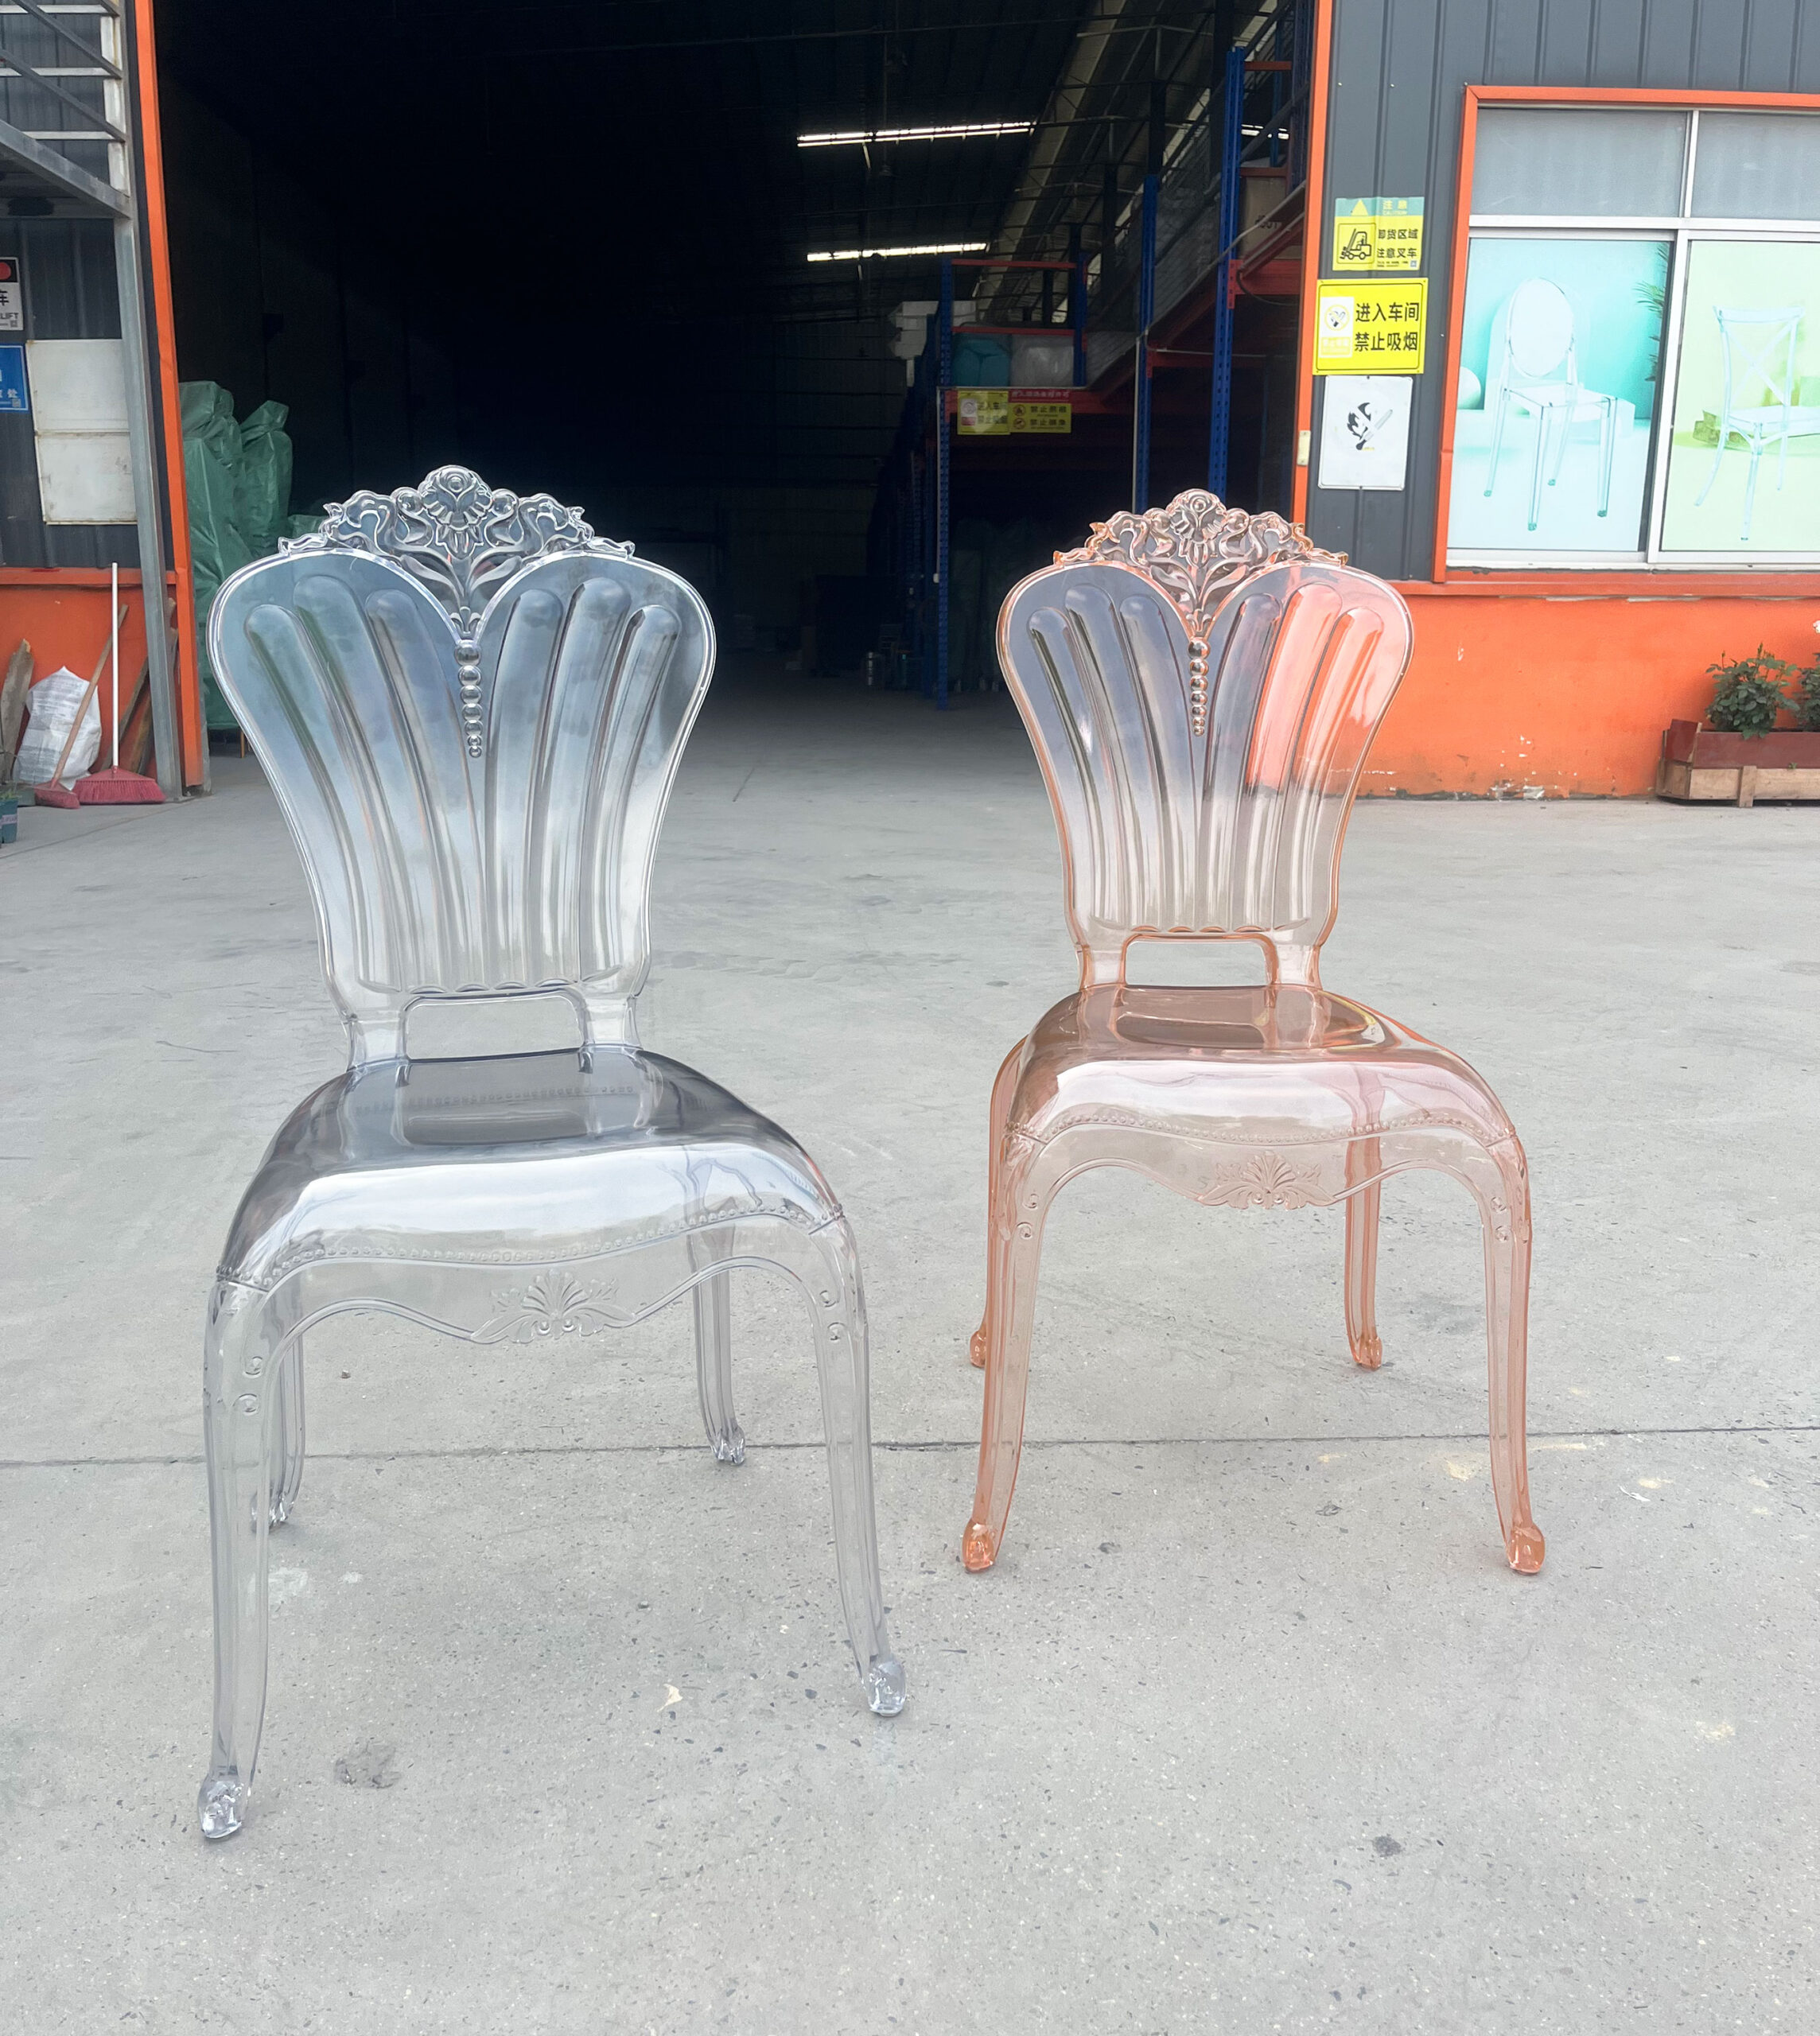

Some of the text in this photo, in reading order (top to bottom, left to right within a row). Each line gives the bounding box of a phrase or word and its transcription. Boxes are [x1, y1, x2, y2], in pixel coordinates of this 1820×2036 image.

[1378, 228, 1418, 239] 卸货区域
[1377, 247, 1418, 258] 注意叉车
[1355, 302, 1420, 322] 进入车间
[1355, 332, 1418, 352] 禁止吸烟
